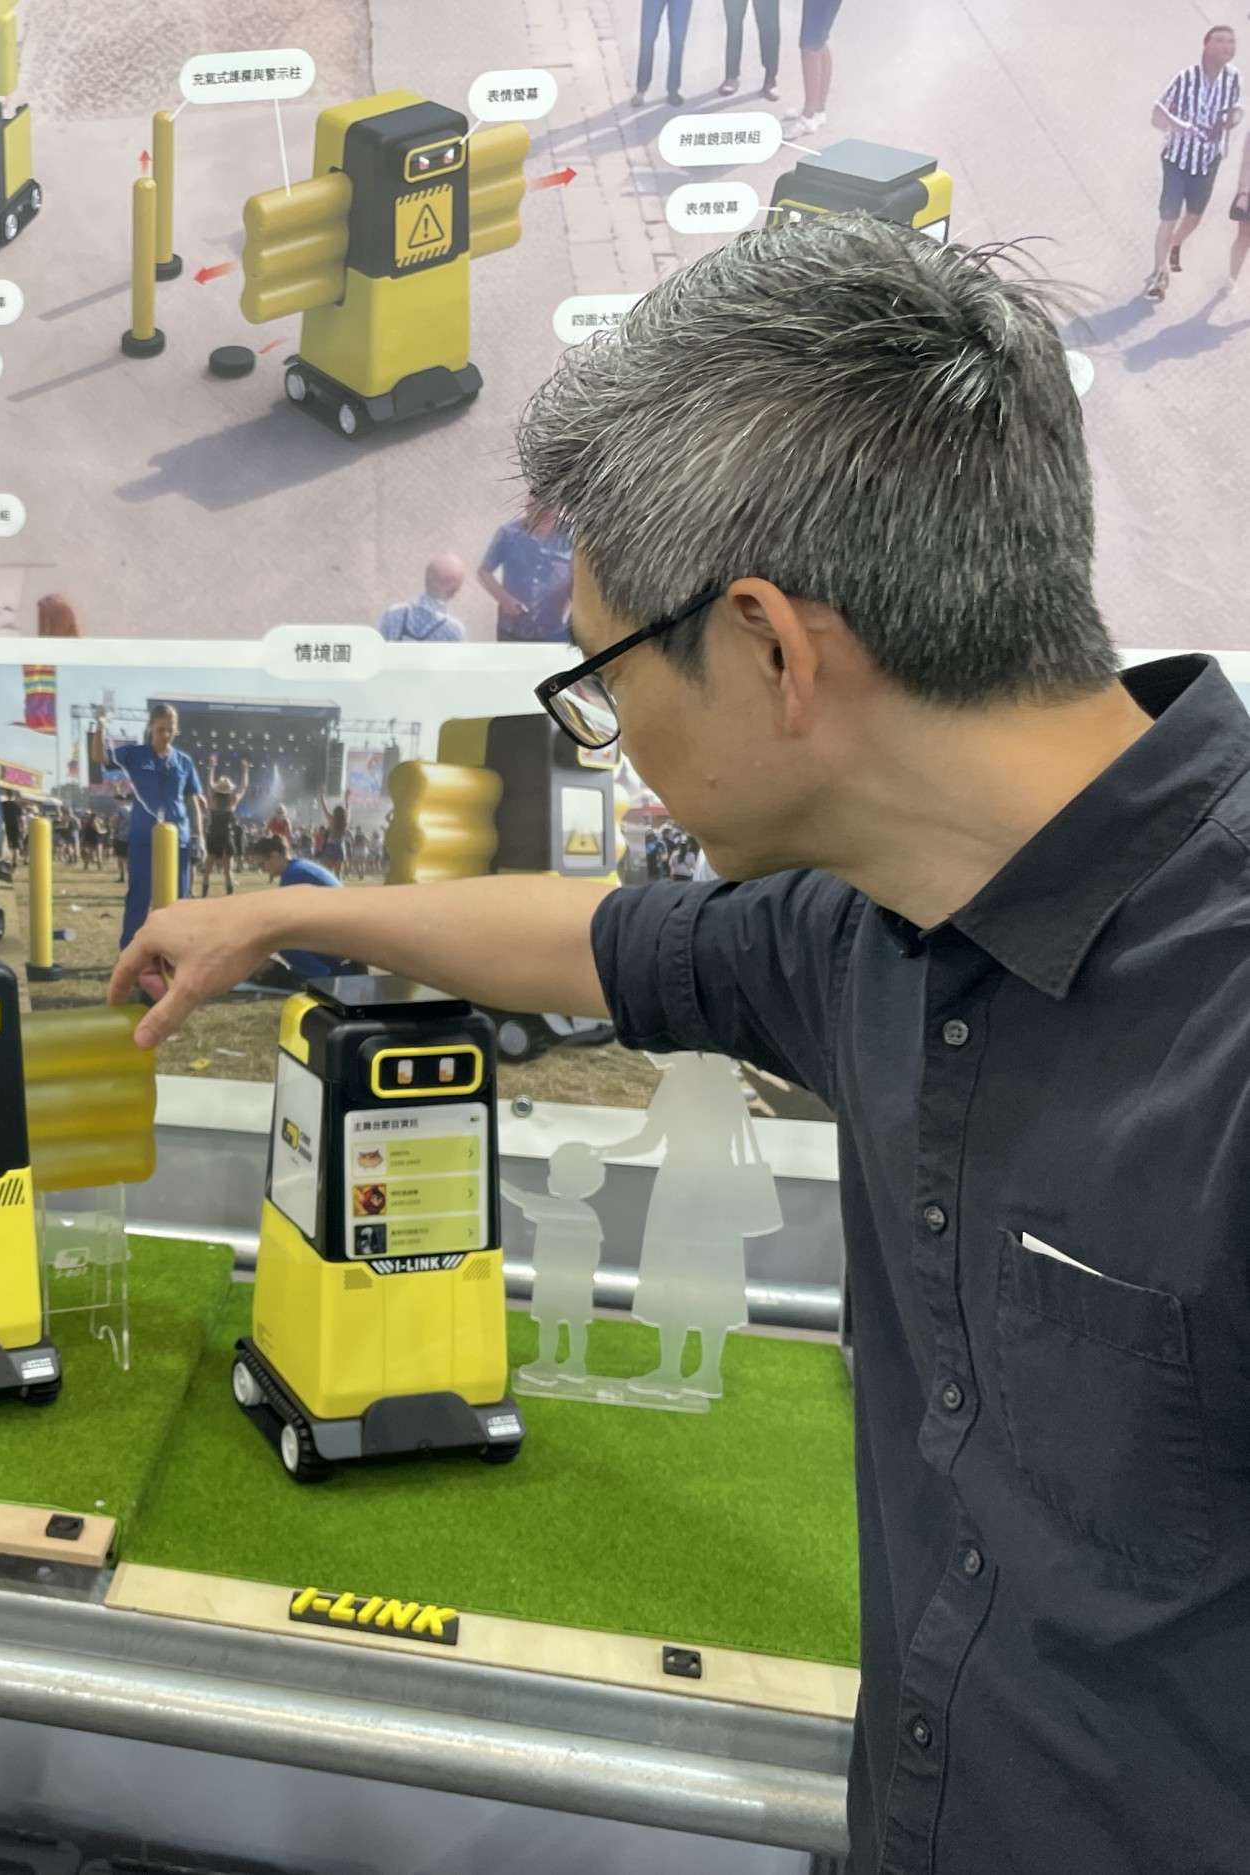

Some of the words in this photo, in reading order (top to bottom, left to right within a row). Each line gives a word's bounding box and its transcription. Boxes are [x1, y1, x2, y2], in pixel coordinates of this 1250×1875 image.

[487, 87, 538, 102] 表情螢幕
[679, 130, 762, 147] 辨識鏡頭模組
[686, 200, 739, 216] 表情螢幕
[295, 643, 351, 663] 情境圖
[395, 1256, 440, 1273] I-LINK
[291, 1586, 459, 1637] I-LINK
